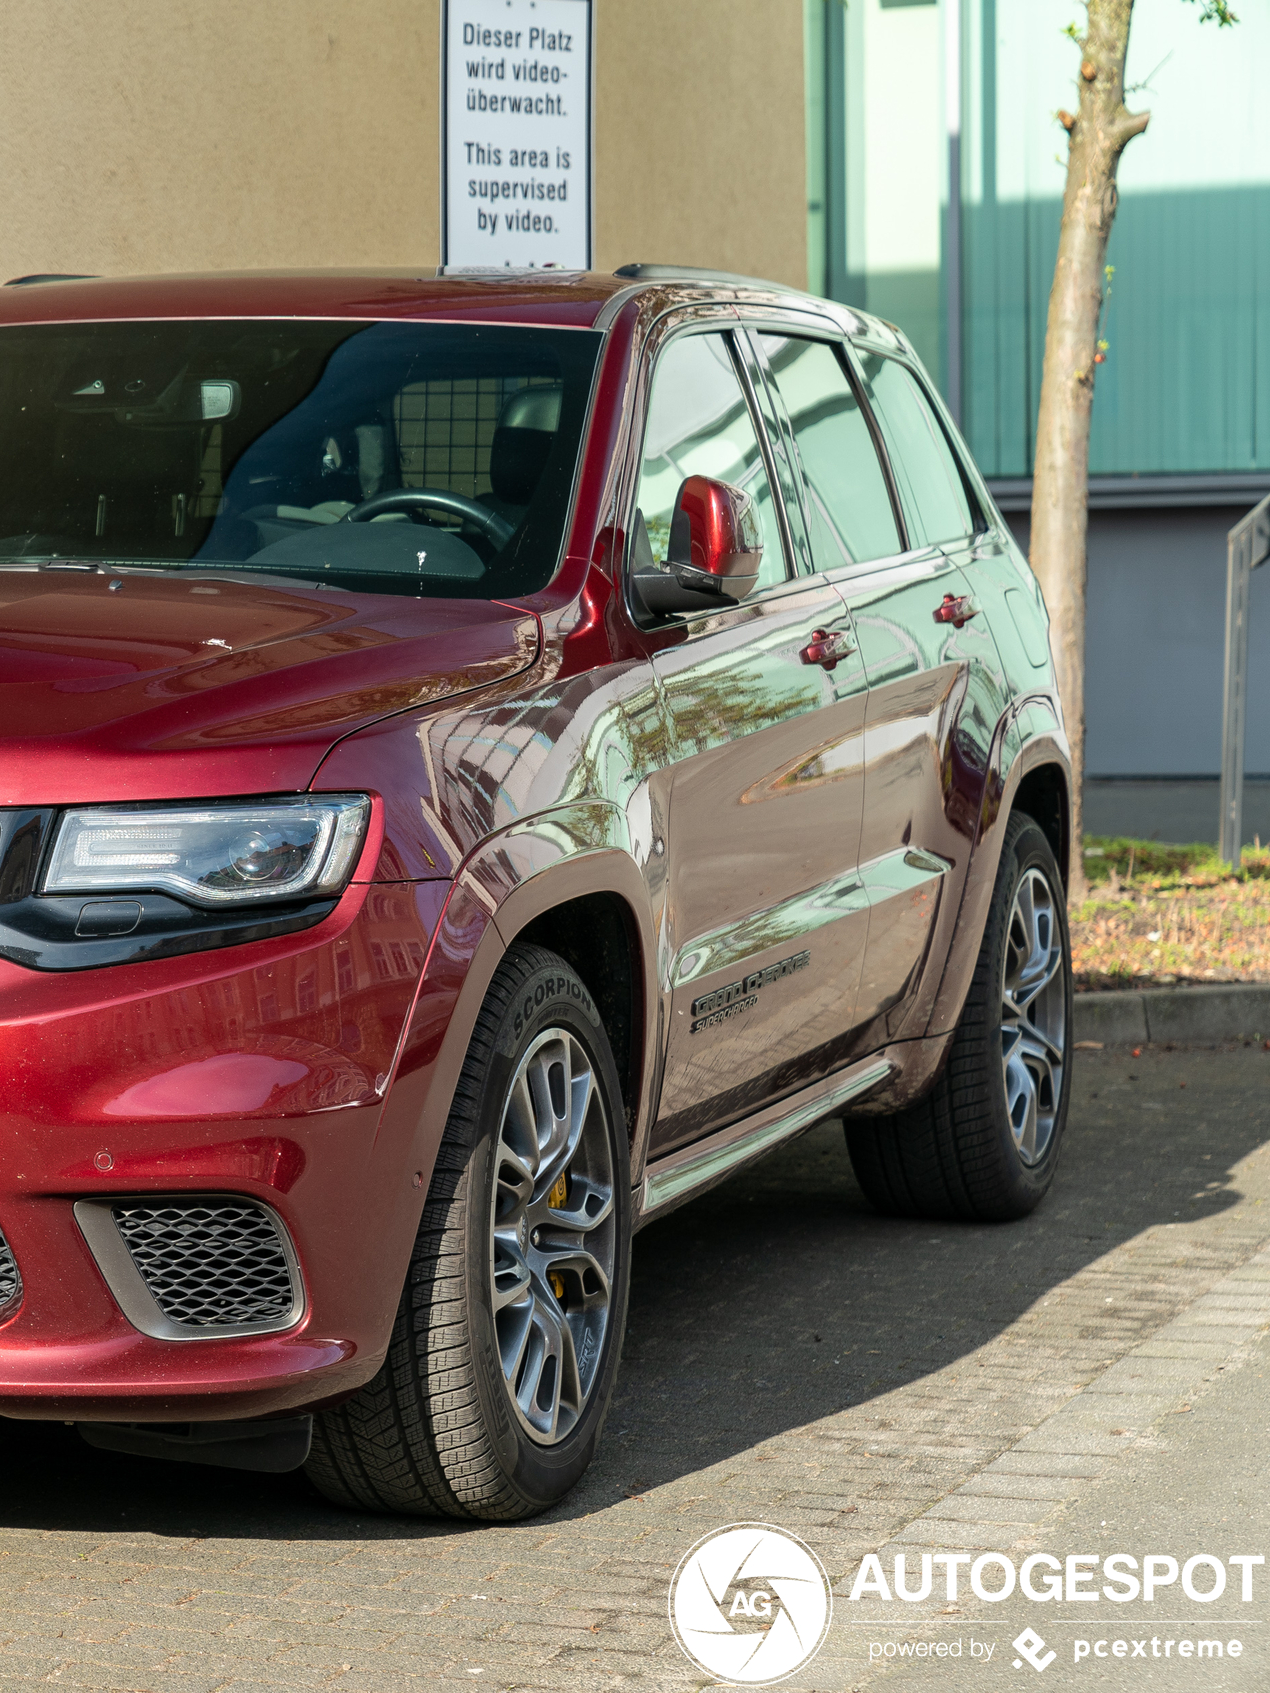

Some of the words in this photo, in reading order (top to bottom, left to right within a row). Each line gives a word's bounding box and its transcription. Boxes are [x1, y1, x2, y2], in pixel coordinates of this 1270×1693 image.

[463, 22, 521, 48] Dieser
[529, 27, 572, 52] Platz
[466, 57, 505, 80] wird
[513, 59, 568, 83] video-
[466, 88, 567, 116] überwacht.
[464, 142, 502, 166] This
[509, 149, 549, 169] area
[556, 147, 571, 169] is
[468, 178, 567, 203] supervised
[478, 208, 498, 235] by
[505, 209, 559, 234] video.
[513, 977, 593, 1041] SCORPION
[693, 981, 743, 1016] GRAND
[578, 1327, 595, 1377] SRT
